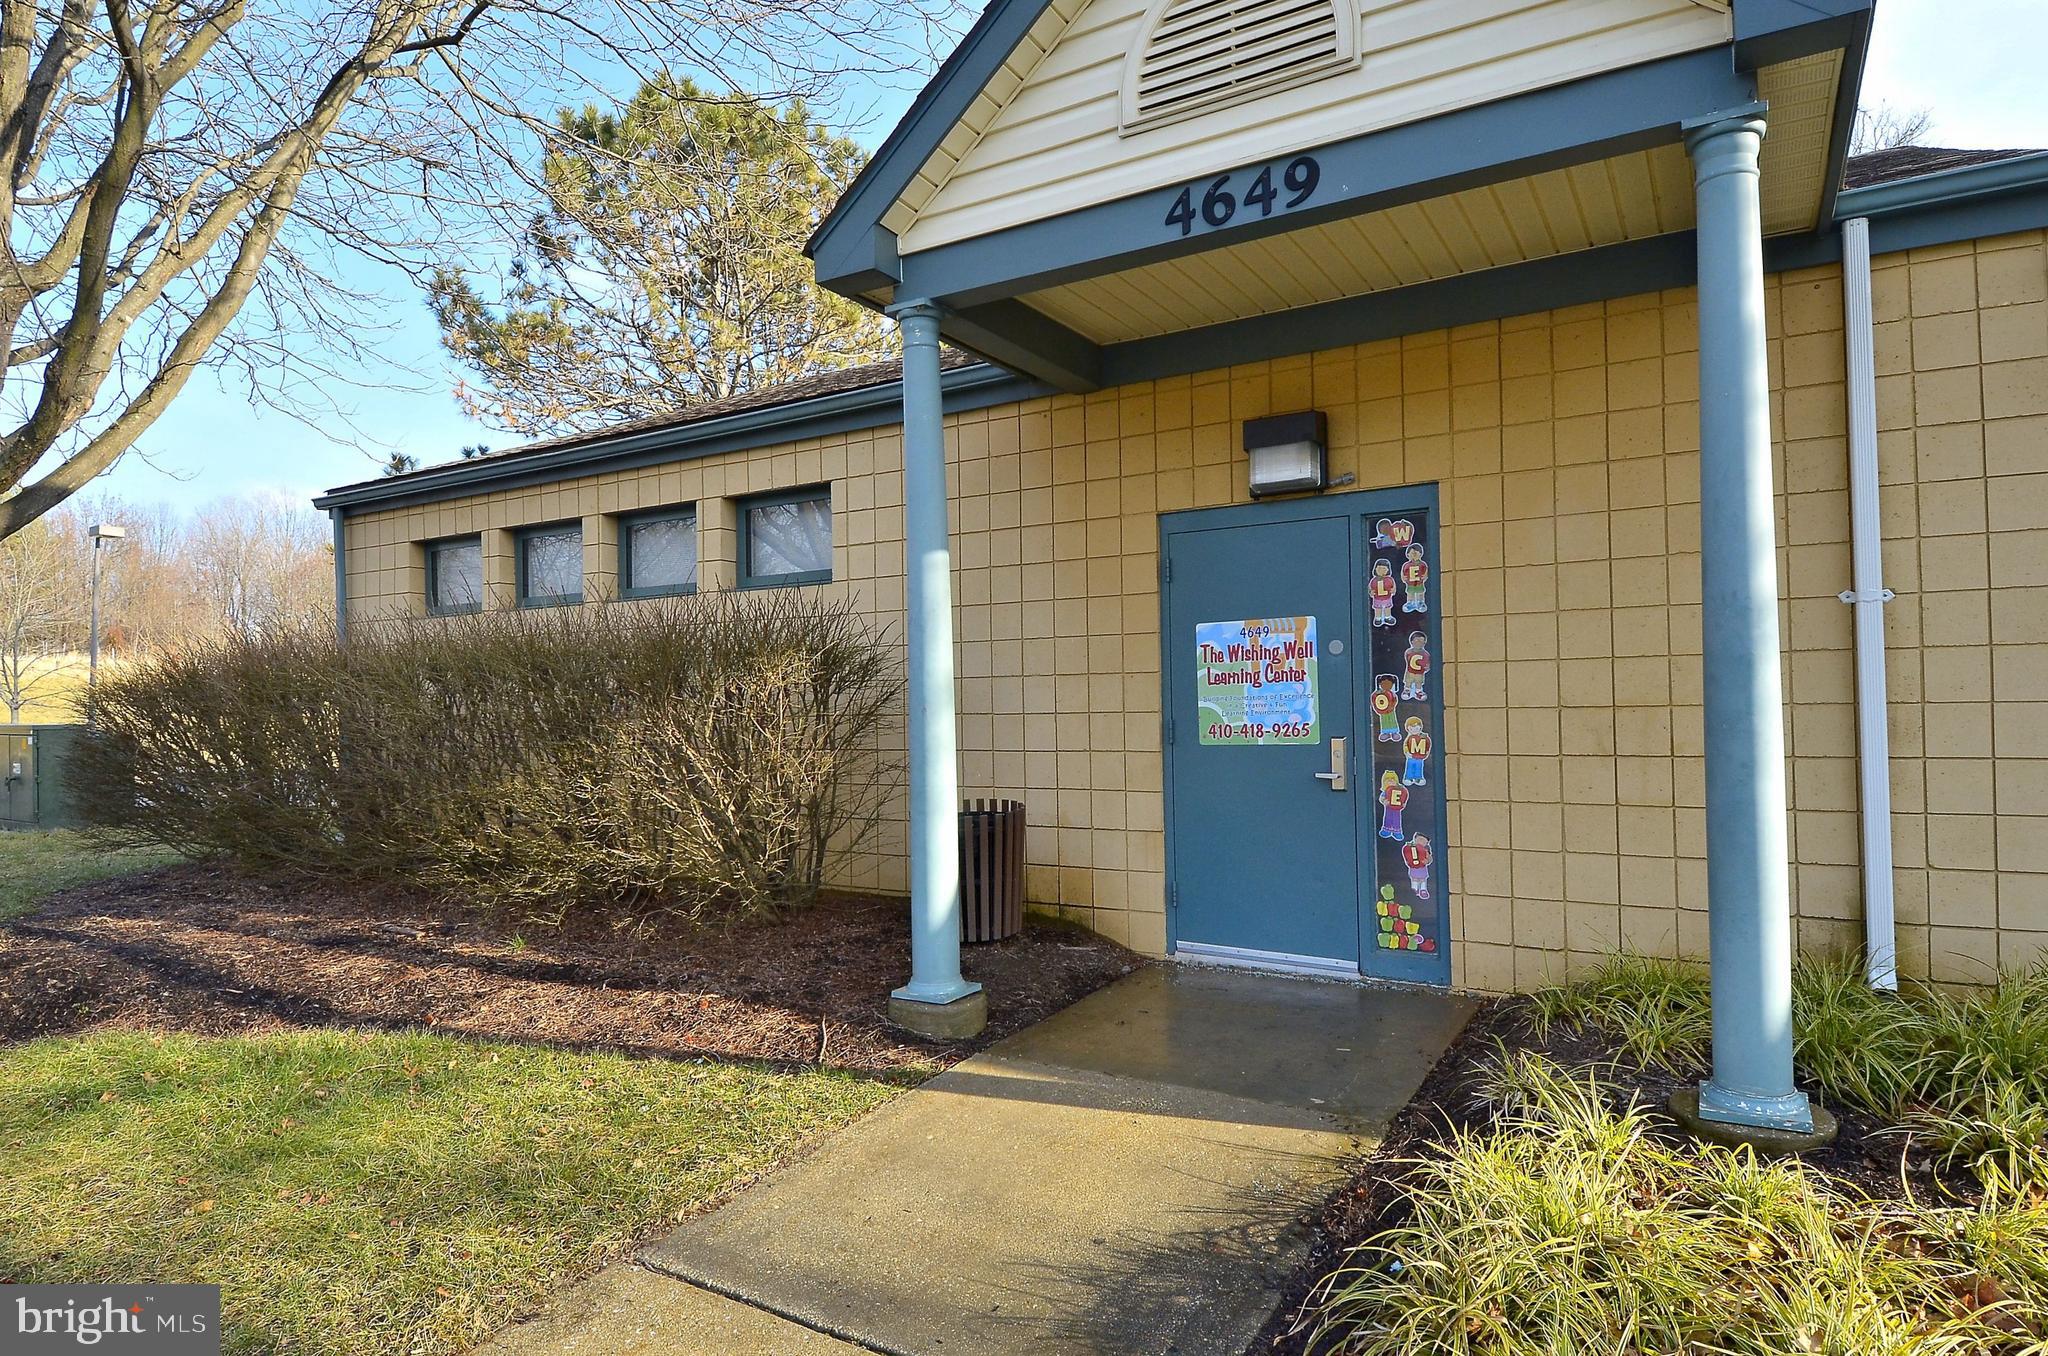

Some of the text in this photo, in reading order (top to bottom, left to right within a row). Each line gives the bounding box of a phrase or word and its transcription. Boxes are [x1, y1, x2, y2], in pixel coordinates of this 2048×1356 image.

[1165, 156, 1320, 235] 4649
[1240, 626, 1269, 638] 4649
[1200, 640, 1313, 663] The Wishing Well
[1207, 663, 1307, 688] Learning Center
[1208, 722, 1310, 739] 410-418-9265
